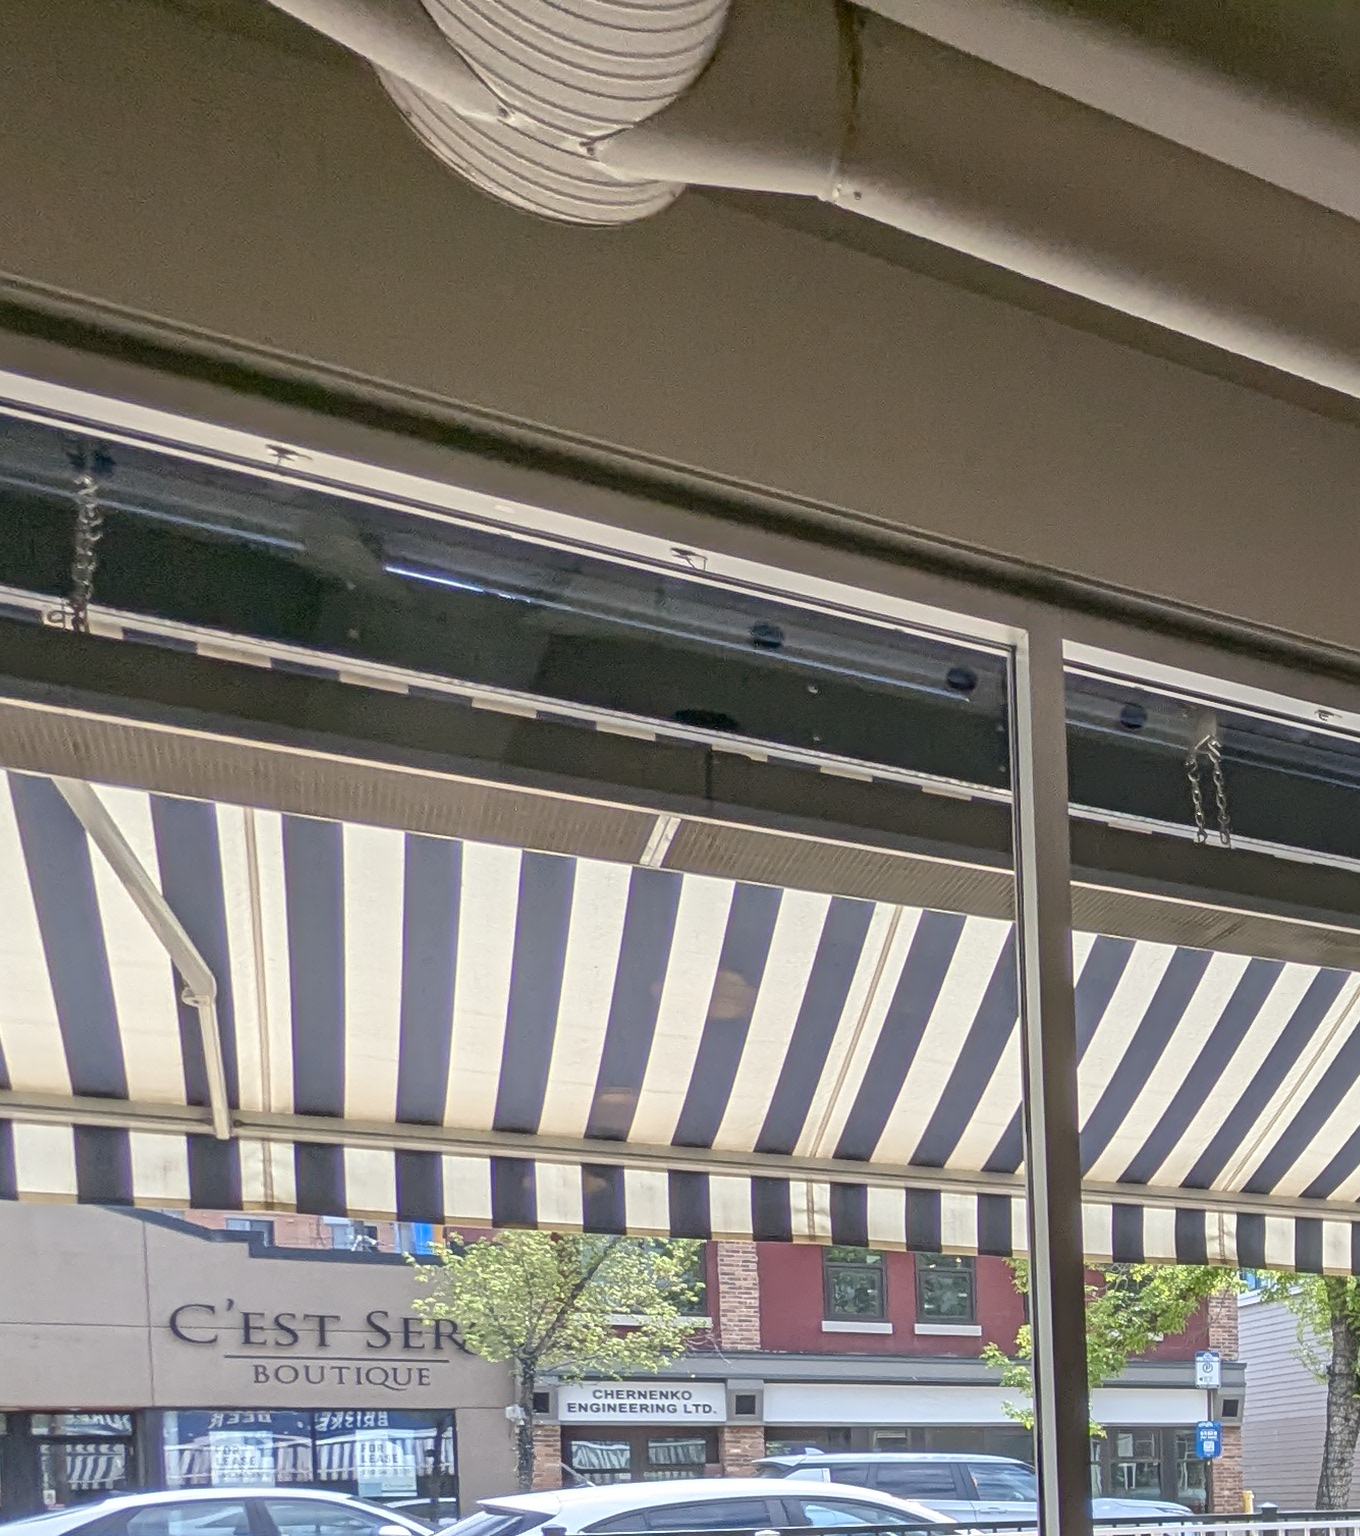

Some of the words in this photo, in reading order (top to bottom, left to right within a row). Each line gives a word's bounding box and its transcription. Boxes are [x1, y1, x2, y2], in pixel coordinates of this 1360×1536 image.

[169, 1299, 341, 1347] C'EST
[366, 1310, 478, 1356] SER
[253, 1364, 432, 1391] BOUTIQUE
[592, 1389, 693, 1401] CHERNENKO
[566, 1402, 678, 1414] ENGINEERING
[683, 1403, 717, 1415] LTD.
[361, 1443, 385, 1454] FOR
[361, 1453, 399, 1465] LEASE
